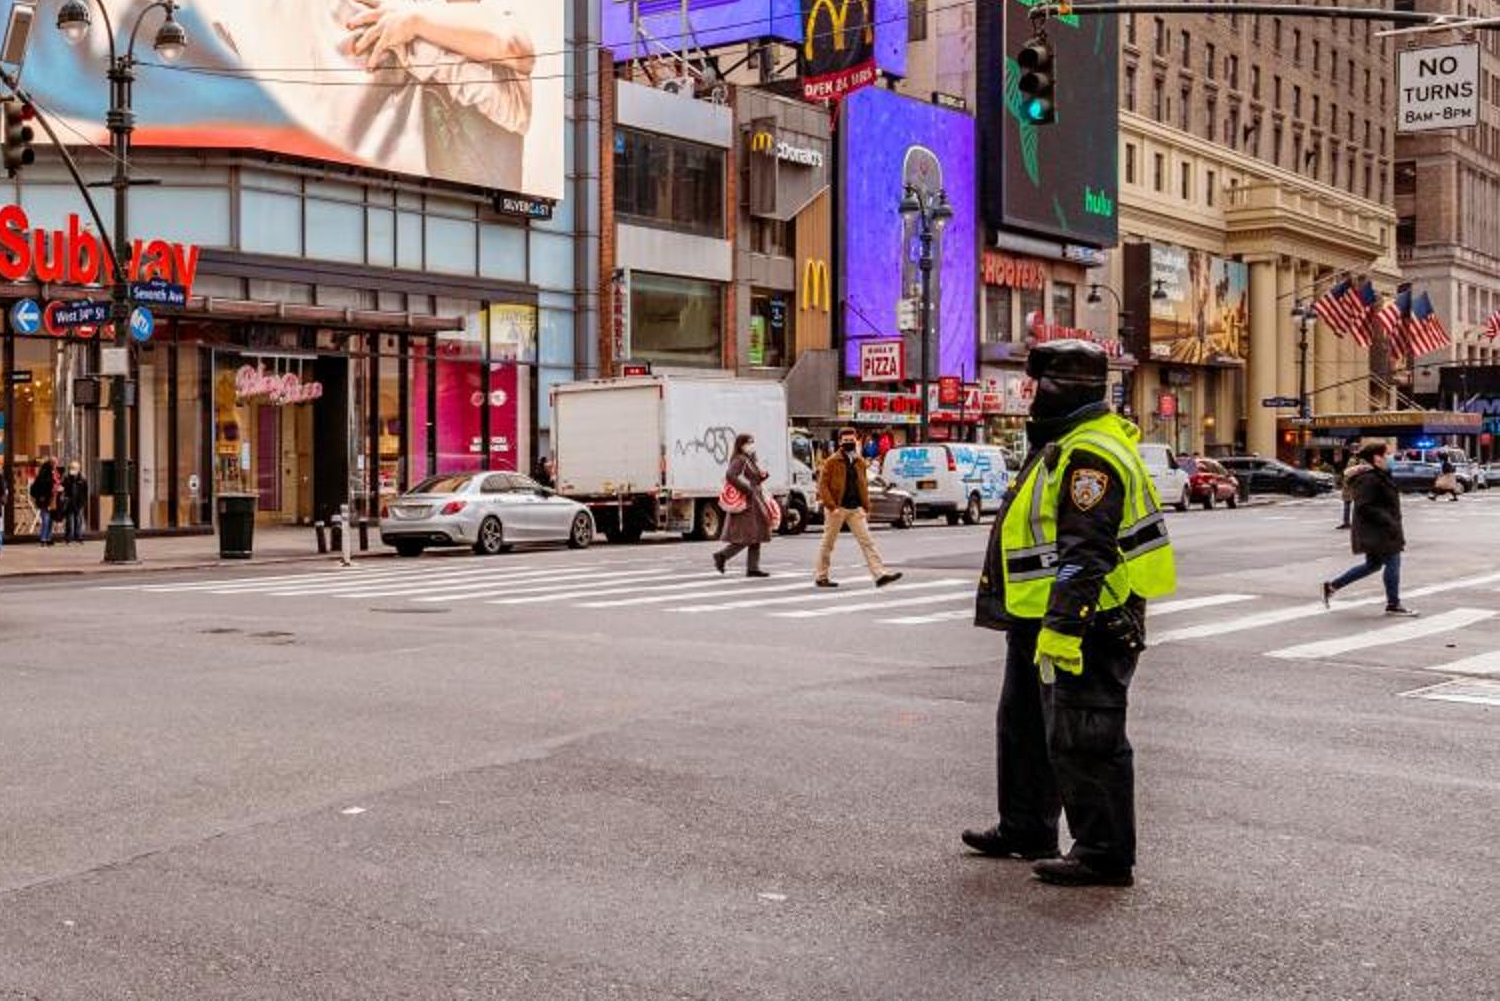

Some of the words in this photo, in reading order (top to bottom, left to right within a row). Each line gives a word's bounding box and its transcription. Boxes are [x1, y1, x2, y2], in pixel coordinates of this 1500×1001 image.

[1419, 56, 1457, 78] NO
[804, 80, 834, 98] OPEN
[835, 79, 849, 92] 24
[1403, 82, 1473, 104] TURNS
[1405, 107, 1472, 124] 8AM-8PM
[765, 141, 823, 168] cDonald's
[1085, 186, 1113, 217] hulu
[984, 251, 1045, 291] HOOTERS
[133, 286, 167, 302] Seventh
[168, 290, 184, 303] Ave
[55, 310, 77, 324] West
[96, 307, 105, 319] St
[864, 355, 897, 378] PIZZA
